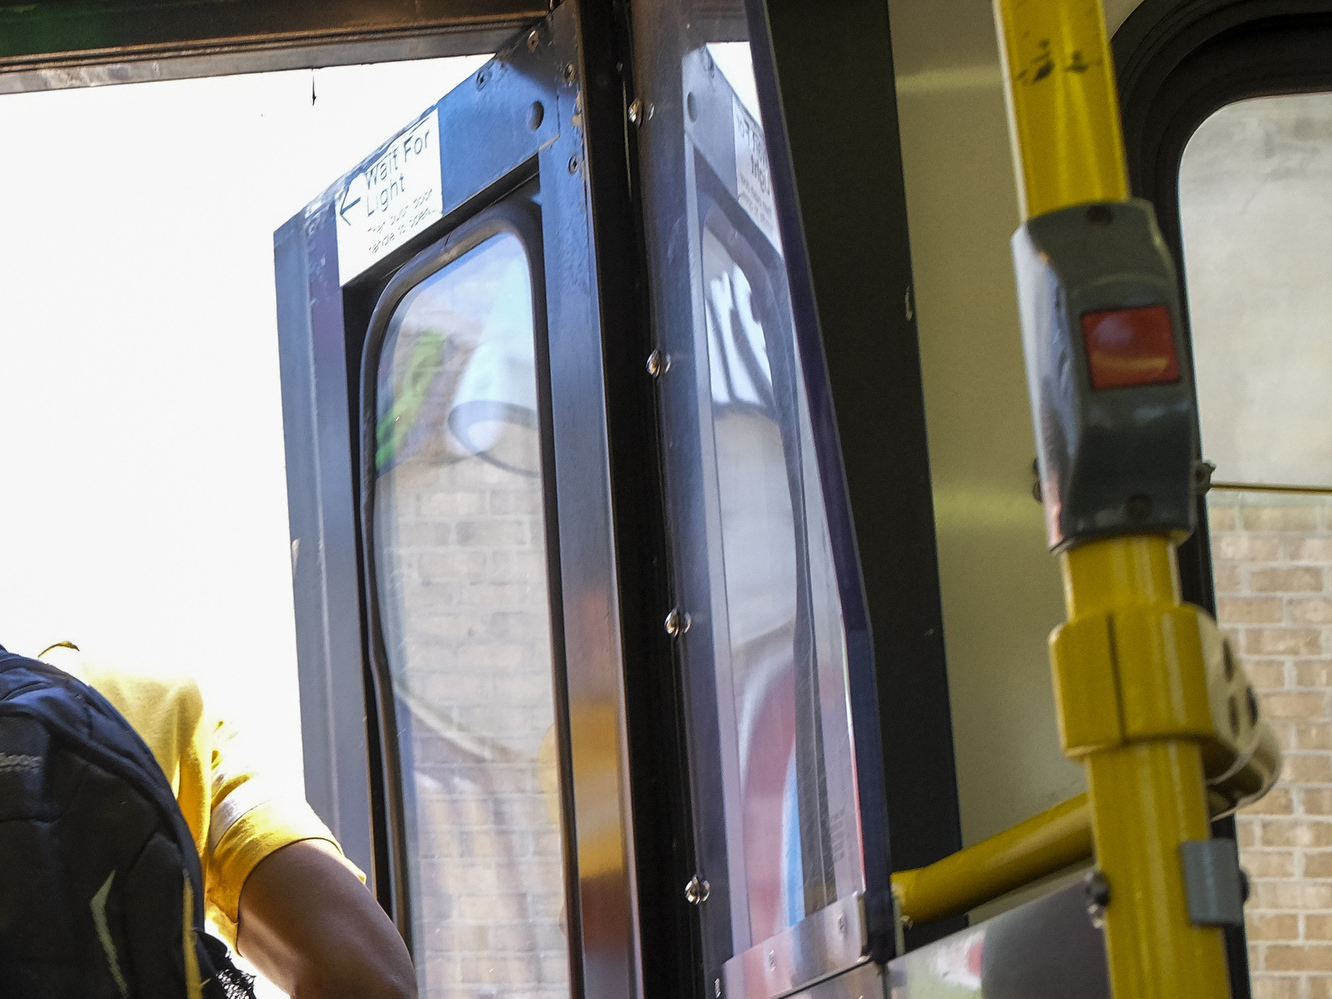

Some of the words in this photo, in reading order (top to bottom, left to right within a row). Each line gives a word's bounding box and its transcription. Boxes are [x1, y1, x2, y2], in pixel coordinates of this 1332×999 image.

[365, 150, 398, 190] Wait
[403, 130, 430, 163] For
[366, 174, 405, 217] Light
